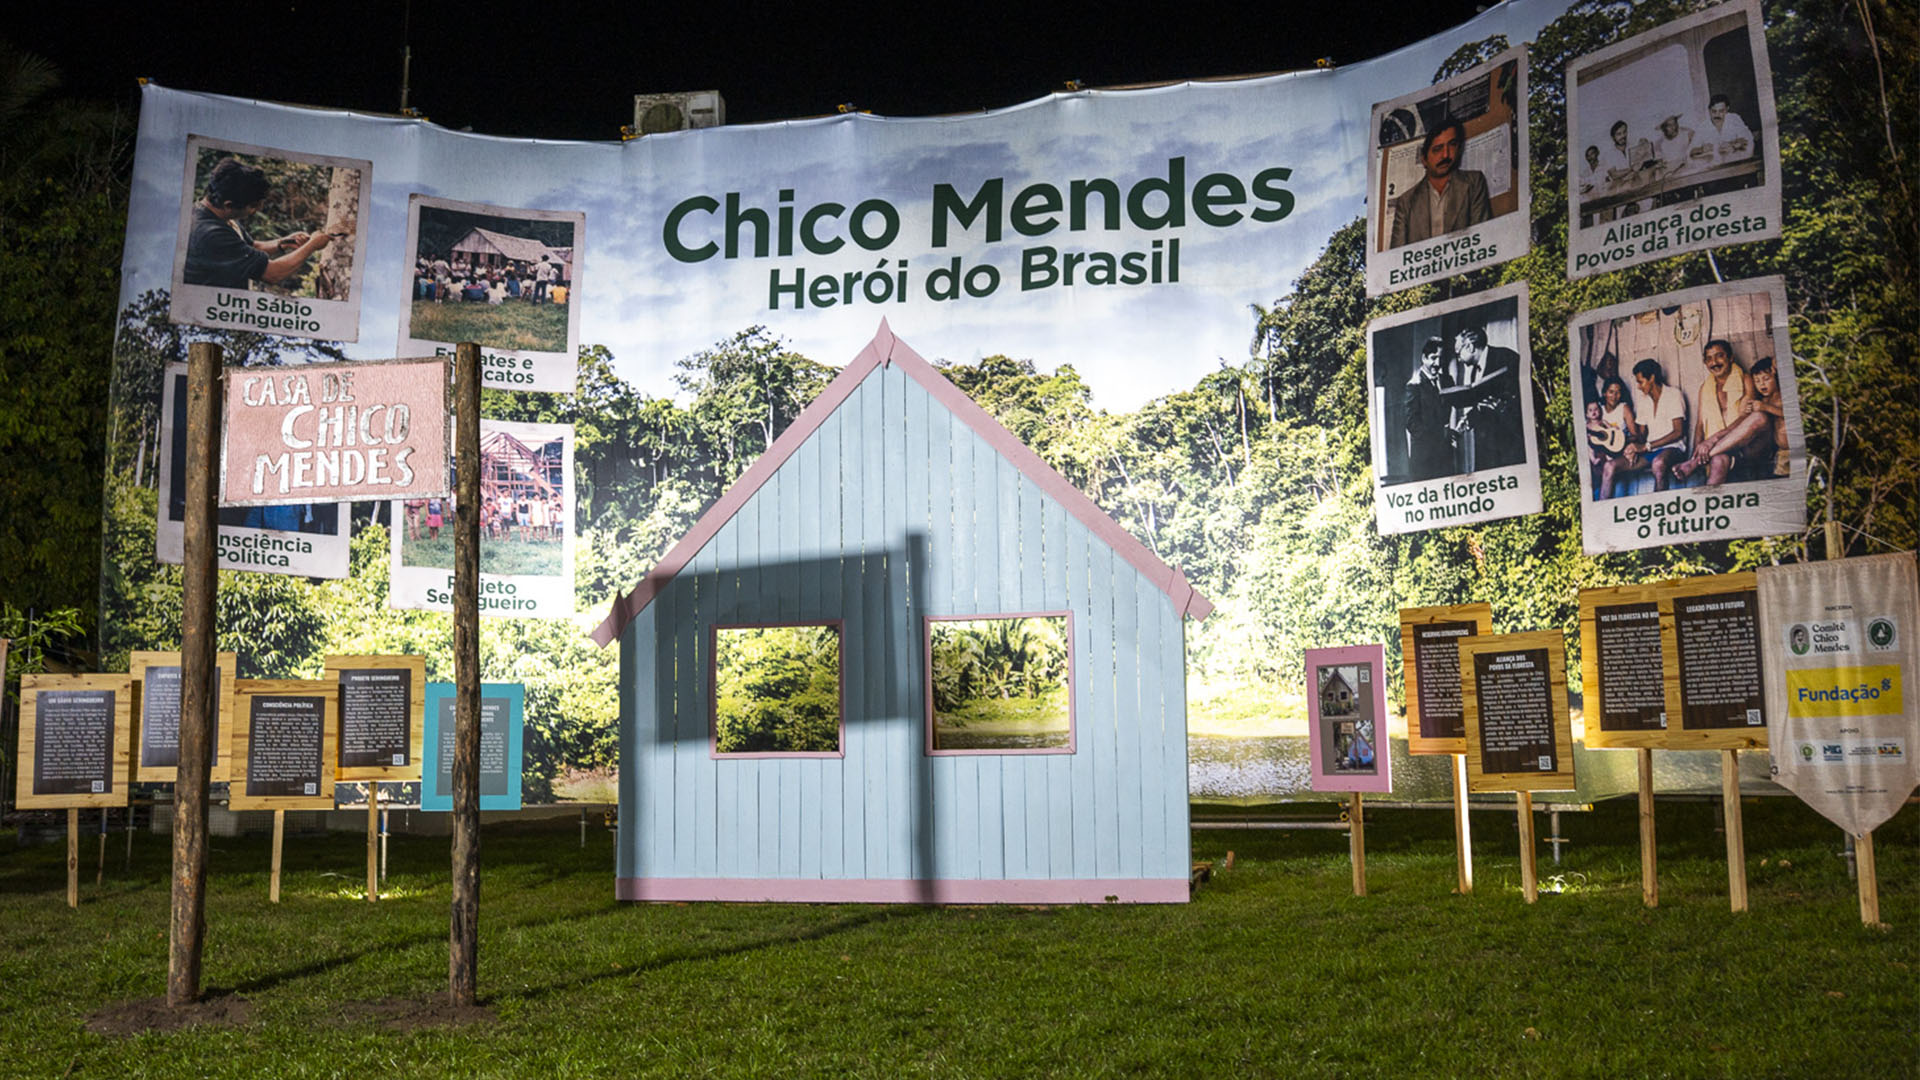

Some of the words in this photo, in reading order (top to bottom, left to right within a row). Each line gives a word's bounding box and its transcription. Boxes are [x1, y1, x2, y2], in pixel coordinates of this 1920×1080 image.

[662, 189, 900, 263] Chico
[931, 156, 1295, 248] Mendes
[1603, 213, 1683, 246] Aliança
[1689, 203, 1732, 223] dos
[1403, 233, 1481, 266] Reservas
[1575, 244, 1635, 271] Povos
[1642, 235, 1669, 253] da
[1676, 215, 1767, 246] floresta
[769, 258, 907, 311] Herói
[925, 257, 1001, 301] do
[1021, 238, 1180, 292] Brasil
[1390, 244, 1497, 285] Extrativistas
[217, 293, 250, 309] Um
[256, 297, 312, 316] Sábio
[206, 306, 320, 332] Seringueiro
[435, 347, 517, 369] Eates
[522, 358, 533, 369] e
[242, 374, 312, 407] CASA
[322, 371, 355, 404] DE
[281, 402, 411, 449] CHICO
[252, 446, 416, 495] MENDES
[1386, 492, 1413, 509] Voz
[1417, 487, 1439, 504] da
[1443, 475, 1519, 500] floresta
[1405, 509, 1425, 523] no
[1429, 496, 1495, 520] mundo
[1613, 496, 1697, 523] Legado
[1705, 492, 1760, 514] para
[1637, 524, 1651, 539] o
[1658, 514, 1731, 536] futuro
[219, 534, 312, 554] nsciência
[447, 575, 517, 595] Pjeto
[426, 589, 537, 611] Sergueiro
[1812, 622, 1845, 633] Comitê
[1813, 633, 1839, 643] Chico
[1814, 642, 1850, 653] Mendes
[1798, 684, 1880, 703] Fundação
